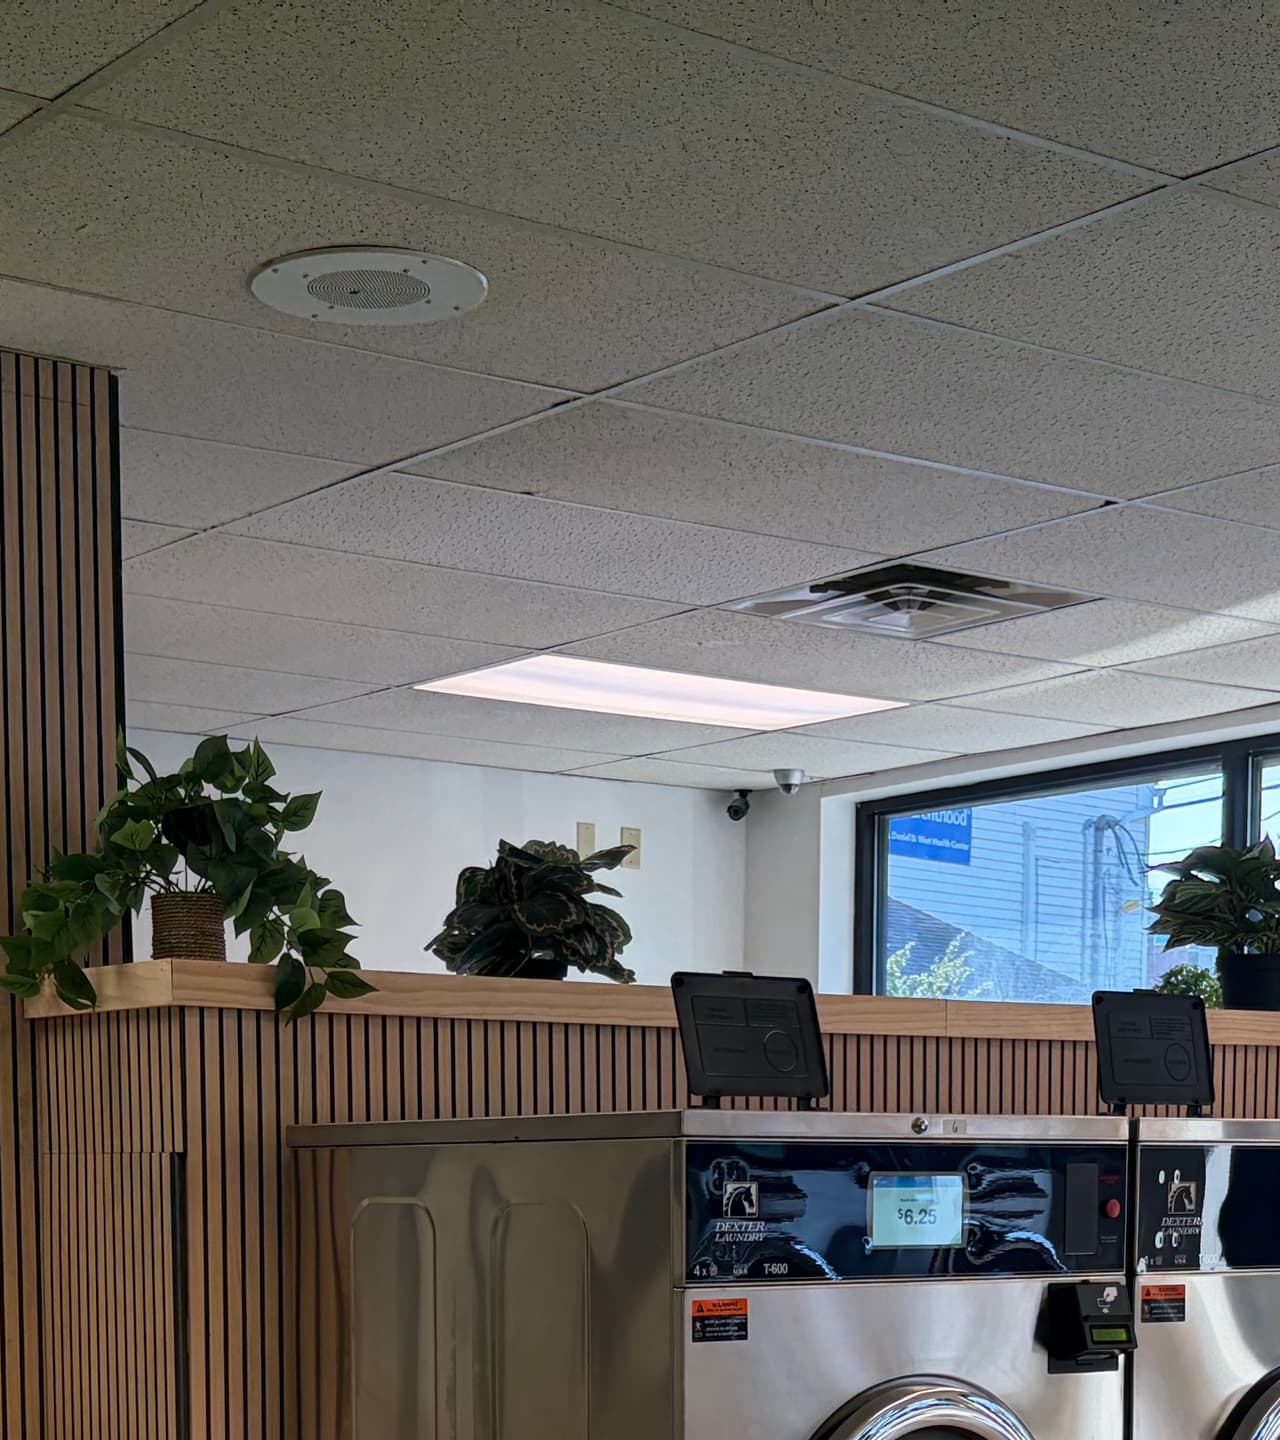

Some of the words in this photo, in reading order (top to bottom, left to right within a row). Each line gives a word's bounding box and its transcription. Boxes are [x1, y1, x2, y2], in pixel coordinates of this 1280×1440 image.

[897, 1208, 937, 1225] $6.25
[1161, 1217, 1202, 1226] DEXTER
[715, 1221, 765, 1231] DEXTER
[715, 1232, 765, 1241] LAUNDRY
[693, 1265, 700, 1277] 4
[763, 1263, 788, 1275] T-600
